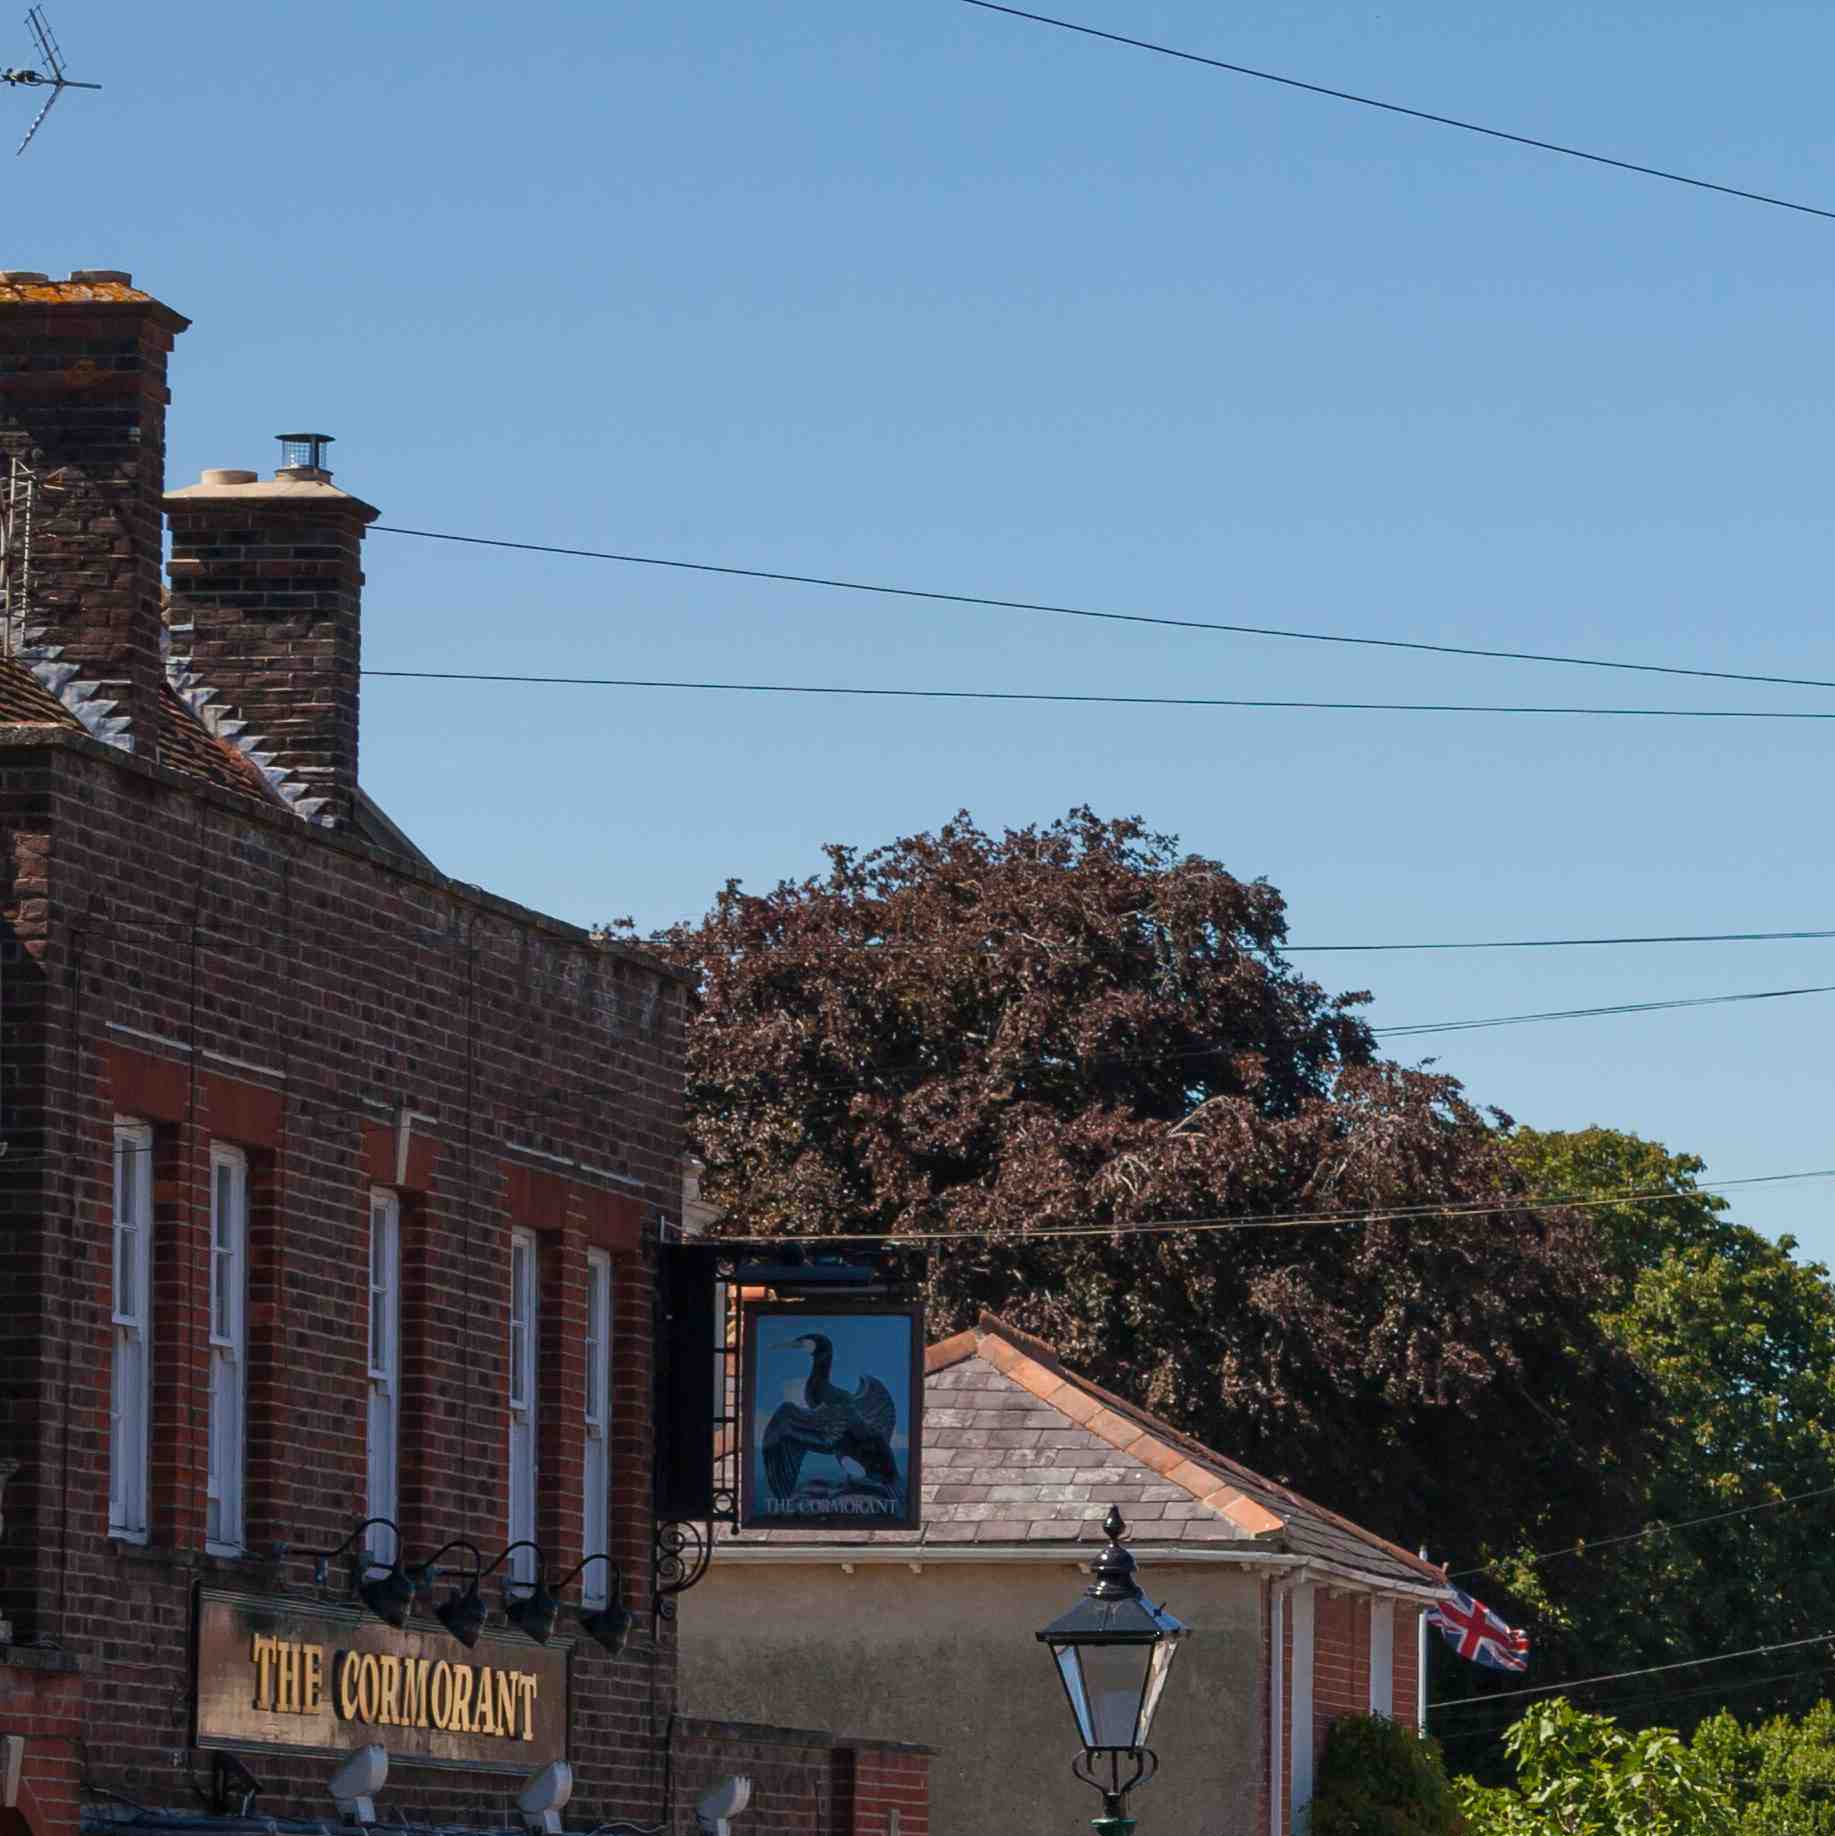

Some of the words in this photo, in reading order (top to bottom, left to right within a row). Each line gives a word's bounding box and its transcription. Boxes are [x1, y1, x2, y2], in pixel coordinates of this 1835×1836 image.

[766, 1500, 794, 1513] THE
[800, 1499, 896, 1513] CORMORANT
[253, 1633, 322, 1714] THE
[341, 1650, 536, 1741] CORMORANT
